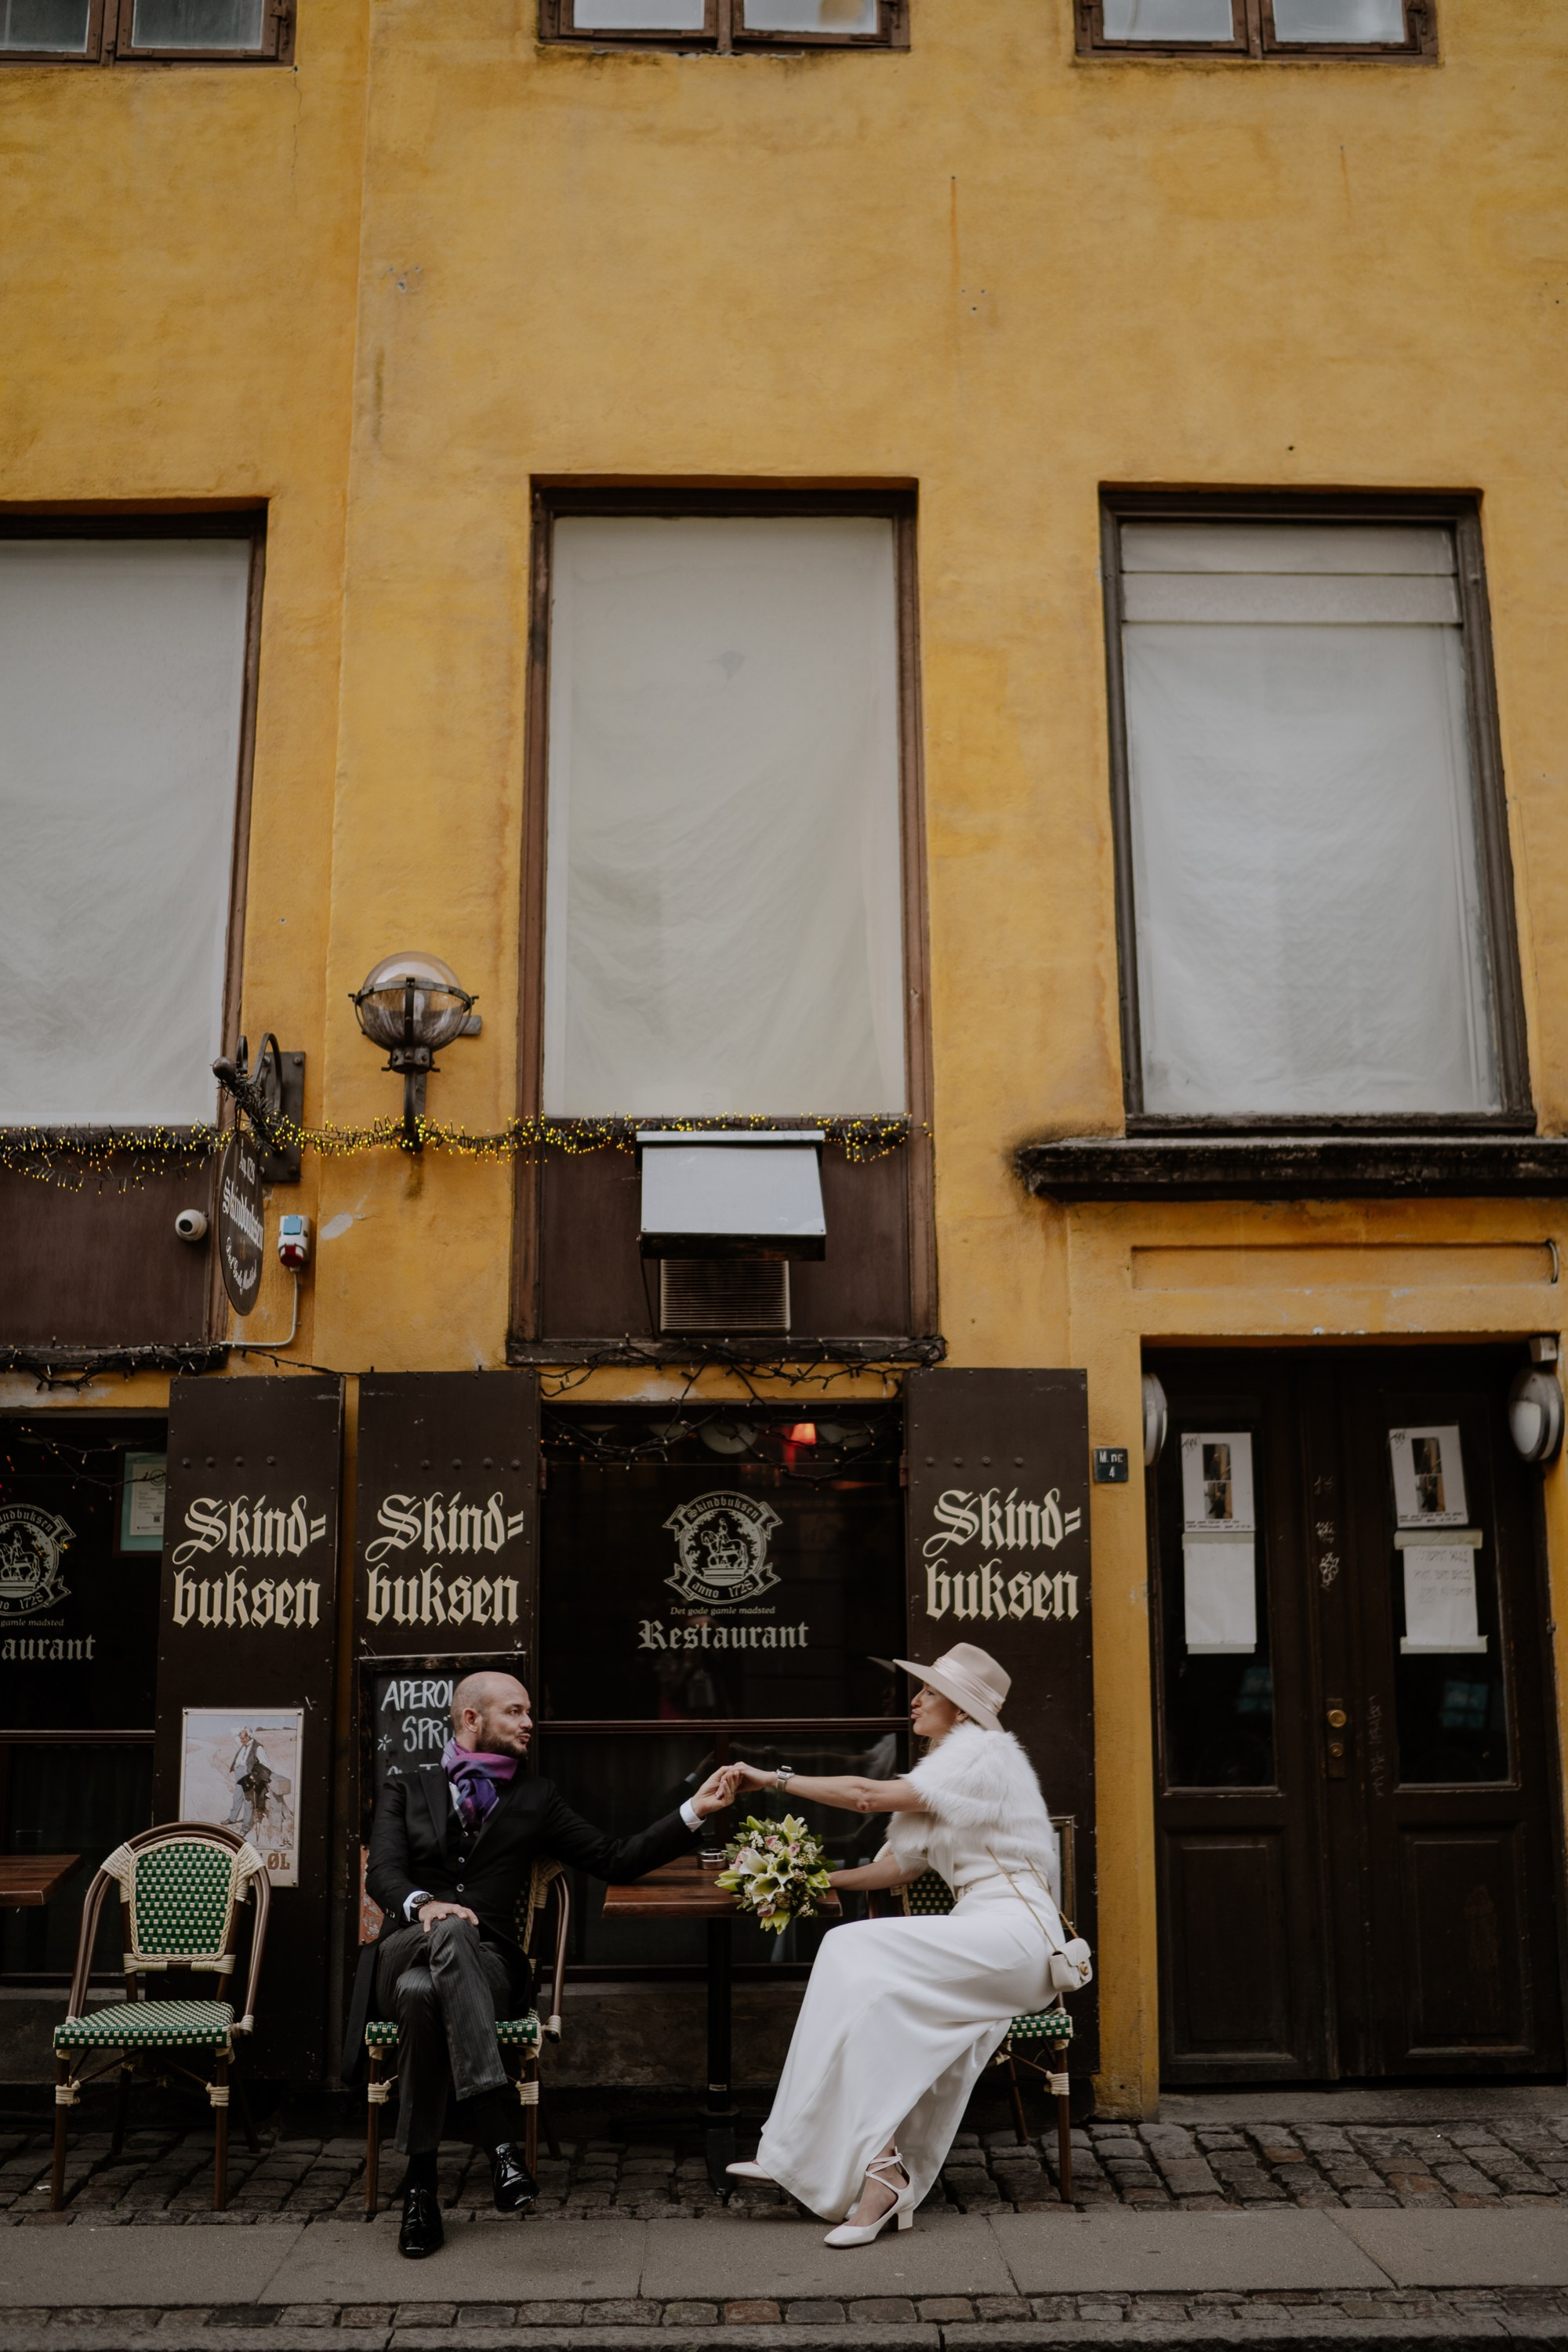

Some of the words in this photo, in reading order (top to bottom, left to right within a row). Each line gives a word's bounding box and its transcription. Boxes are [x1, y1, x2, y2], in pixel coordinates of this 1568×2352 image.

[1109, 1466, 1115, 1478] 4
[687, 1496, 759, 1520] Skindbuksen
[172, 1565, 321, 1628] buksen
[365, 1563, 519, 1626] buksen
[691, 1581, 719, 1599] anno
[728, 1579, 753, 1598] 1728
[924, 1558, 1080, 1621] buksen
[20, 1592, 44, 1610] 1728
[688, 1606, 708, 1616] gode
[710, 1606, 736, 1616] gamle
[1, 1618, 26, 1628] gamle
[28, 1618, 64, 1627] madsted
[637, 1620, 809, 1650] Restaurant
[267, 1853, 290, 1870] ØL
